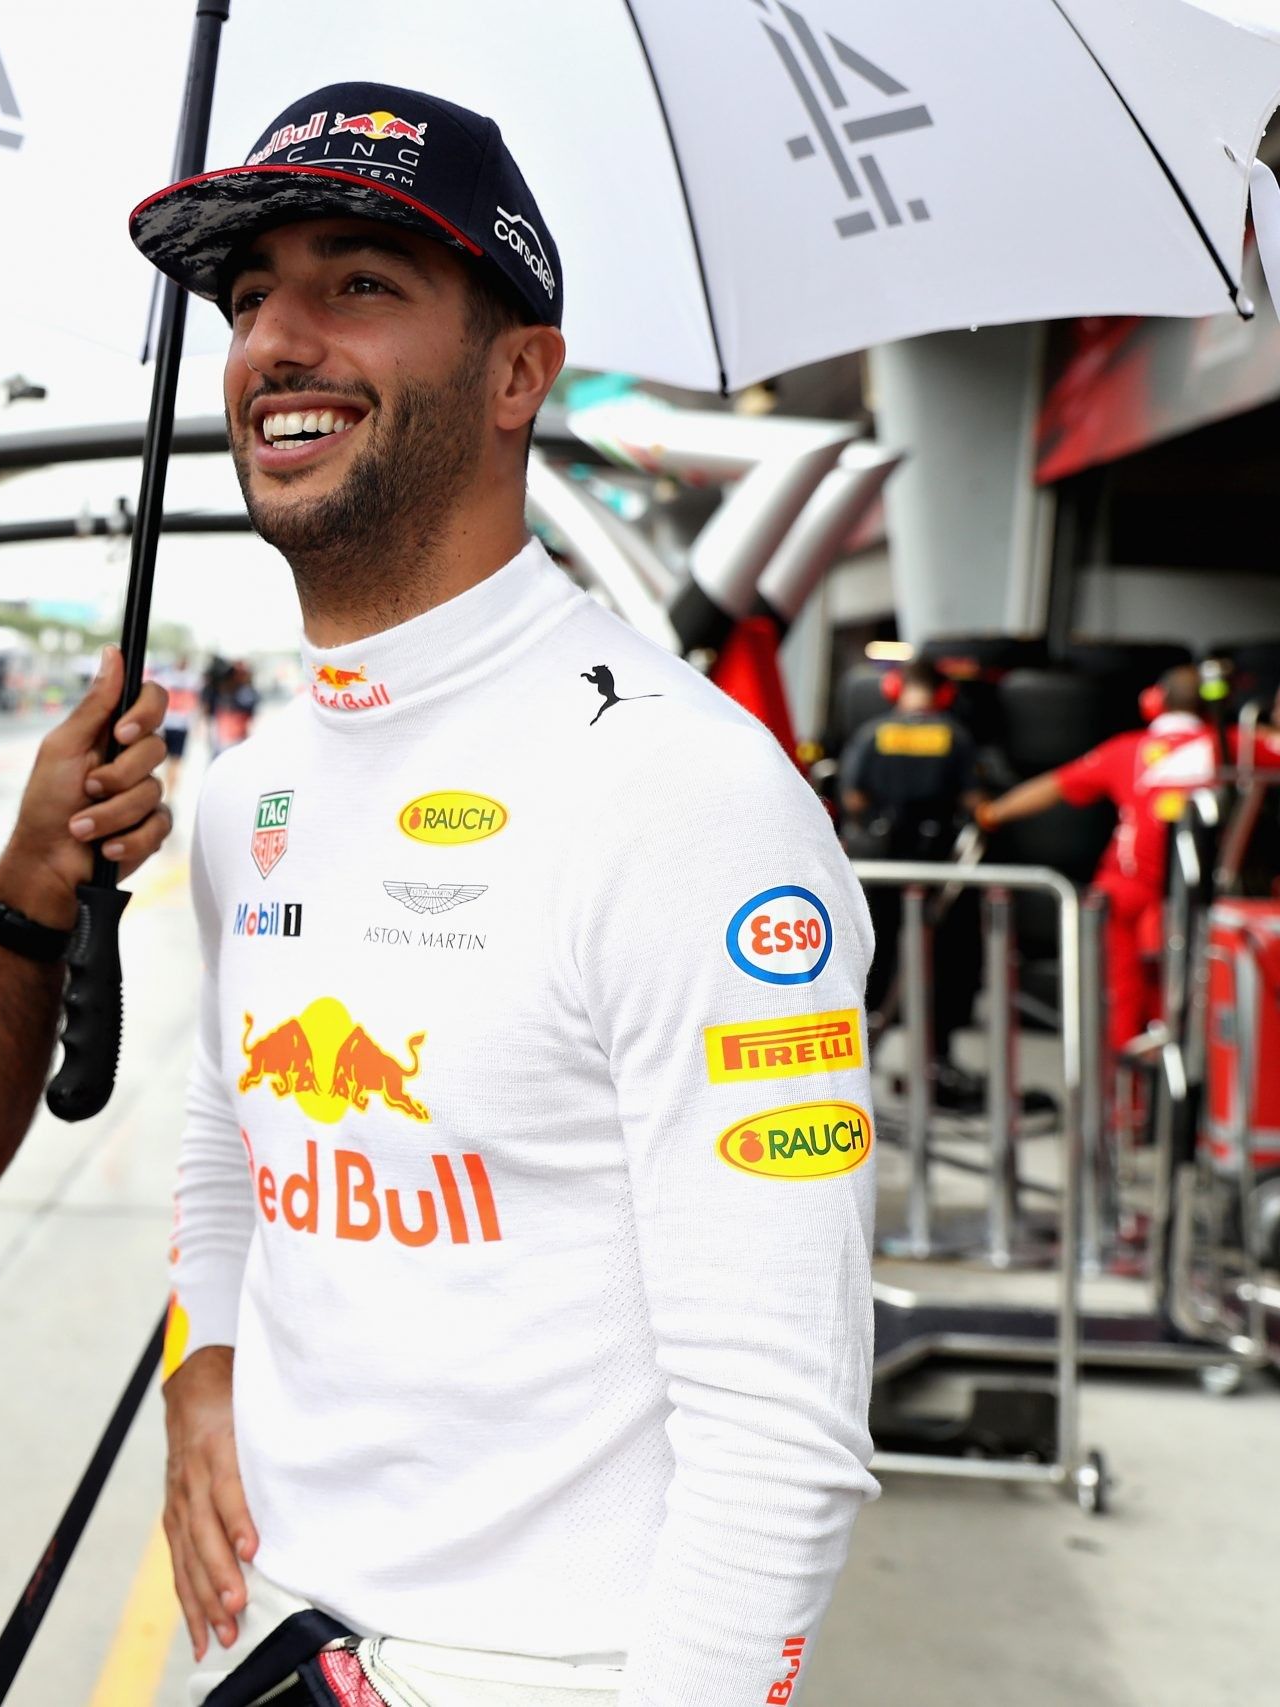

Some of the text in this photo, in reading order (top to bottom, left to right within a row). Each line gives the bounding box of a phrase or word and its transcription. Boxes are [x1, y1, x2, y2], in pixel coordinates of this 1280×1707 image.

[274, 111, 328, 152] Bull
[286, 141, 421, 168] CING
[356, 166, 415, 188] TEAM
[493, 219, 554, 300] carsales
[342, 683, 391, 710] Bull
[260, 801, 288, 827] TAG
[423, 807, 496, 830] RAUCH
[255, 831, 286, 872] HEUER
[232, 903, 299, 937] Mobil 1
[363, 926, 488, 950] ASTON MARTIN
[750, 915, 822, 956] Esso
[721, 1021, 854, 1071] PIRELLI
[768, 1119, 864, 1160] RAUCH
[240, 1126, 318, 1234] ed
[333, 1149, 503, 1247] Bull
[766, 1637, 806, 1706] Bull
